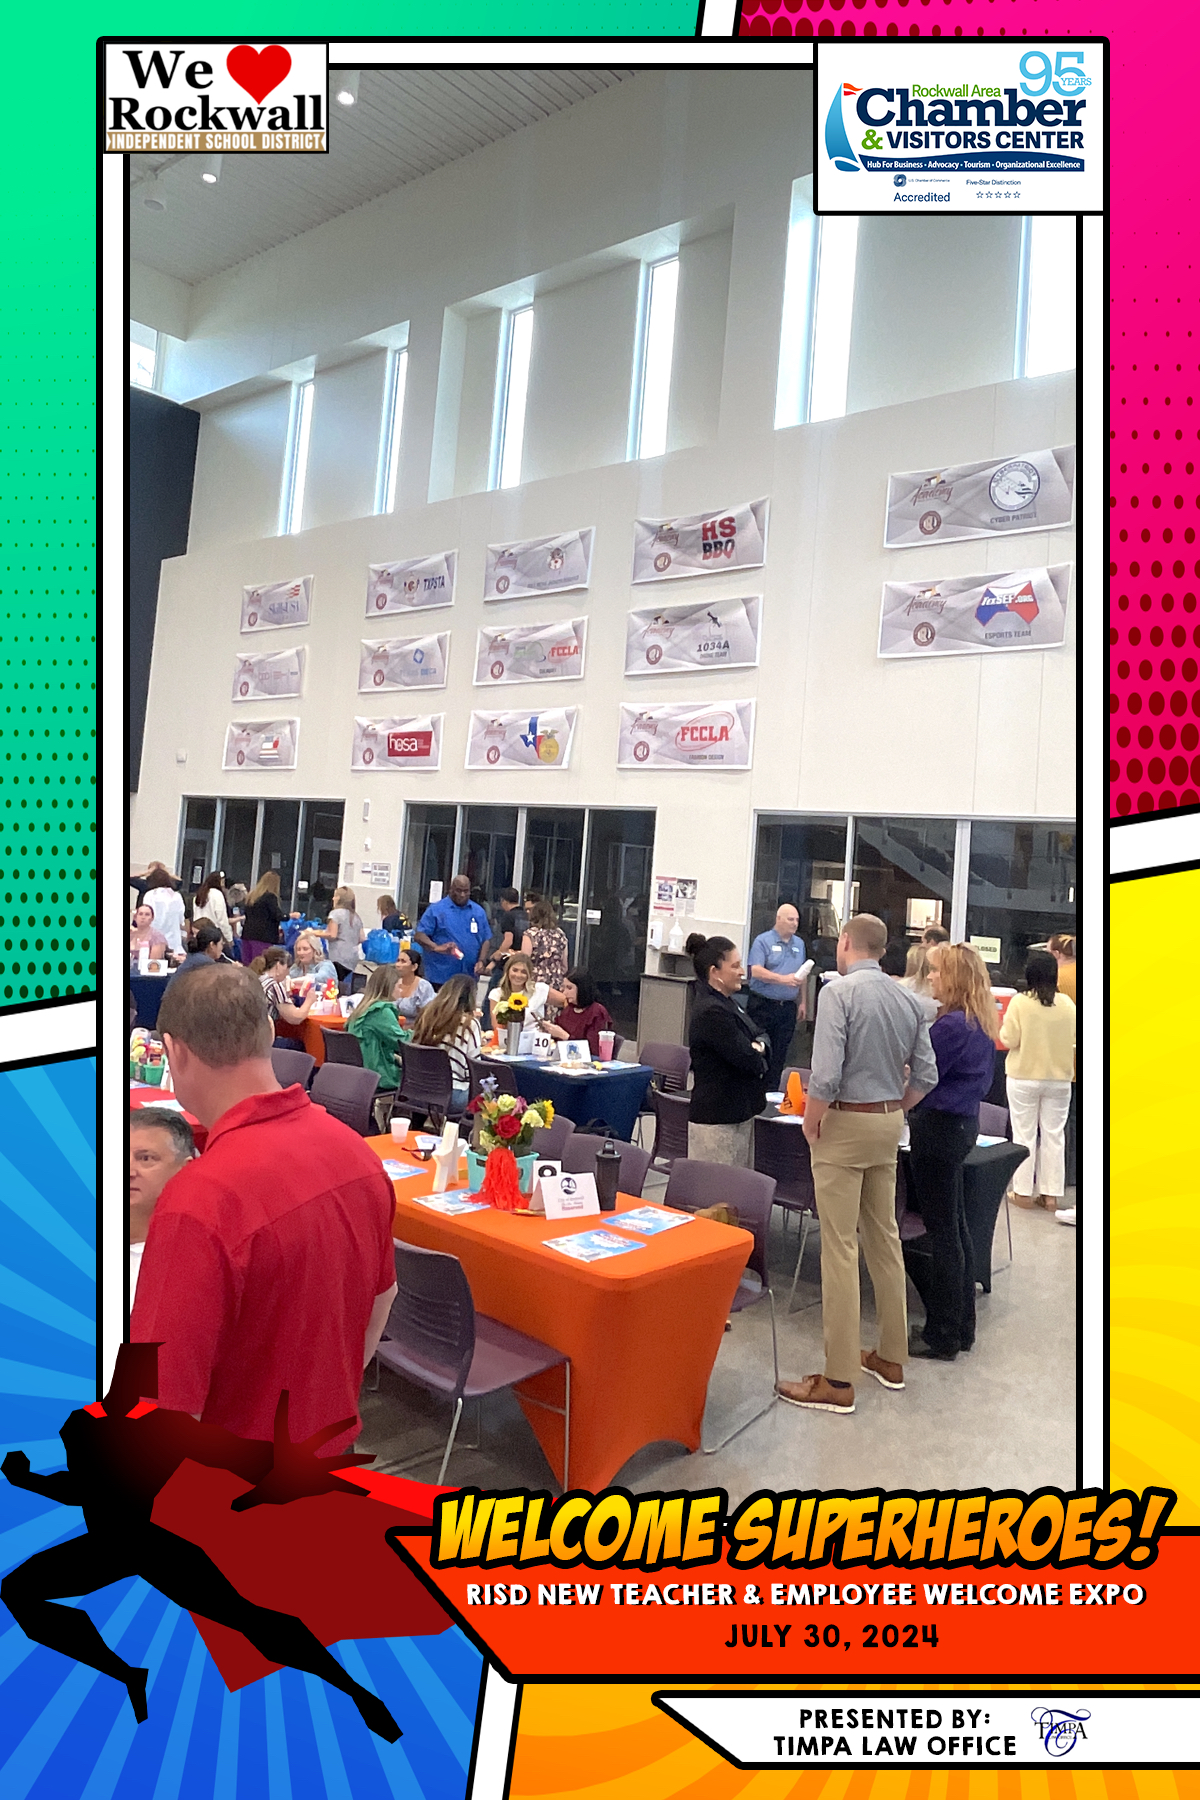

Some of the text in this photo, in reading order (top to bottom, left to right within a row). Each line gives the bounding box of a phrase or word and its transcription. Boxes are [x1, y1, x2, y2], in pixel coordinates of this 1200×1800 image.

[702, 516, 737, 541] HS
[702, 539, 735, 560] BBQ
[985, 631, 1012, 639] ESPORTS
[551, 645, 579, 657] FCCLA
[697, 640, 730, 653] 1034A
[680, 726, 730, 742] FCCLA
[534, 1038, 549, 1048] 10
